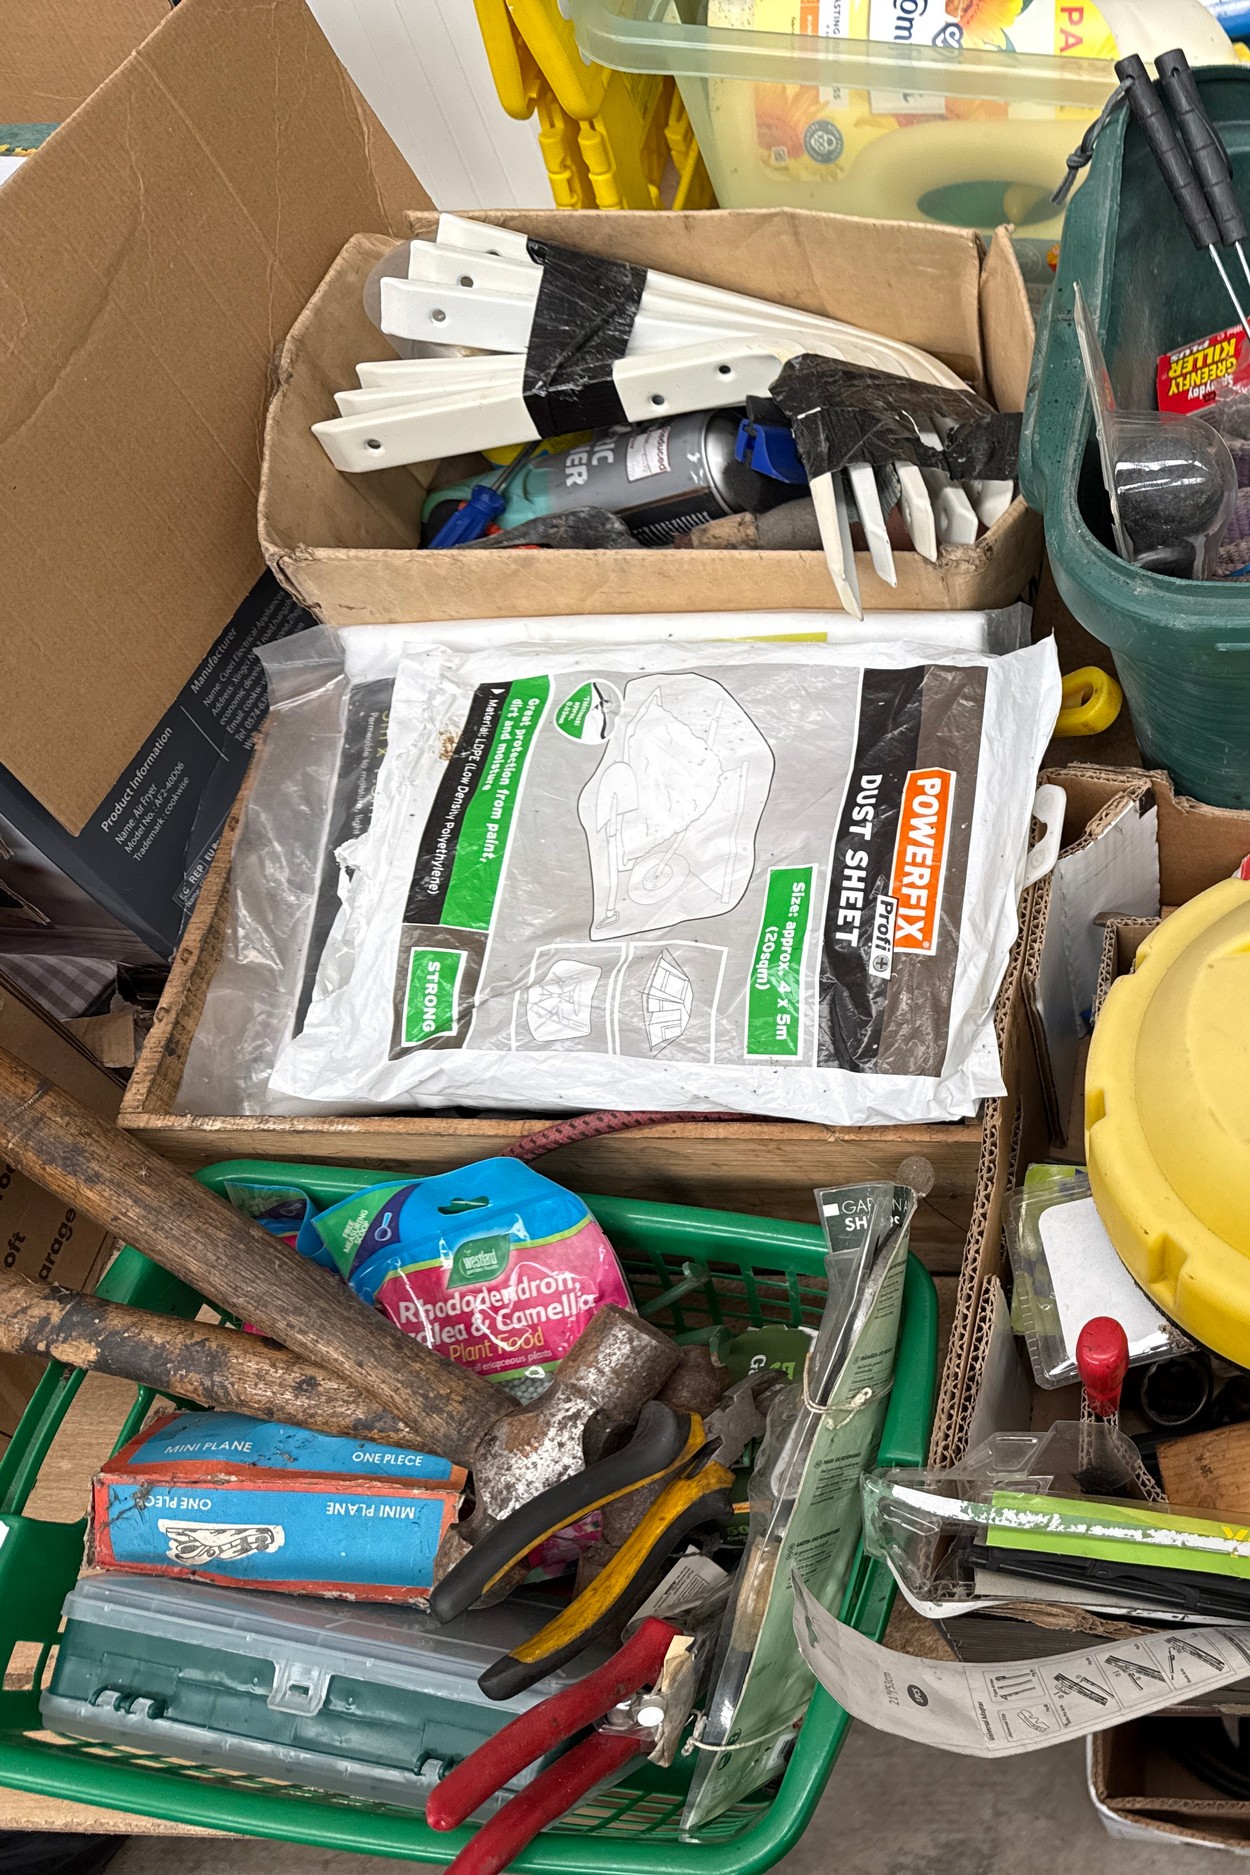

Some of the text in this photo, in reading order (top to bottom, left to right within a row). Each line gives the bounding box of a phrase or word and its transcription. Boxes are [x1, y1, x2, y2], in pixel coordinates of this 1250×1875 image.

[1060, 6, 1083, 53] PA
[1165, 337, 1239, 378] KILLER
[1167, 339, 1210, 362] PLUS
[1165, 355, 1238, 396] GREENFLY
[189, 626, 238, 694] Manufacturer
[201, 626, 260, 708] Name: Cuori Electrical
[209, 684, 235, 717] Address:
[217, 687, 246, 726] economic
[224, 707, 247, 735] Email:
[362, 712, 379, 757] Permeable
[481, 697, 524, 792] dirt and moisture
[100, 725, 174, 832] Product Information
[360, 758, 369, 769] to
[477, 696, 540, 863] Great protection from paint,
[113, 781, 160, 845] Name: Air Fryer
[123, 760, 186, 853] Model AF2-40D06
[132, 774, 192, 863] Trademark cookwise
[423, 697, 500, 894] Material: LDPE (Low Density Polyethylene)
[349, 813, 363, 835] light
[188, 864, 204, 885] REP
[835, 773, 884, 948] DUST SHEET
[876, 897, 895, 952] Profi
[755, 925, 779, 991] (20sqm)
[776, 881, 806, 1041] Size: approx. 4 x 5m
[421, 960, 444, 1034] STRONG
[341, 1219, 355, 1238] FREE
[342, 1207, 368, 1254] MEASURING
[353, 1219, 370, 1245] SCOOP
[399, 1266, 579, 1327] Rhododendron,
[468, 1289, 598, 1336] & Camellia
[448, 1325, 544, 1364] Plant Food
[526, 1346, 552, 1360] plants
[163, 1437, 423, 1468] MINI PLANE ONE PLECE
[178, 1494, 415, 1522] MINI PLANE ONE
[976, 1700, 997, 1740] Universal Adapter
